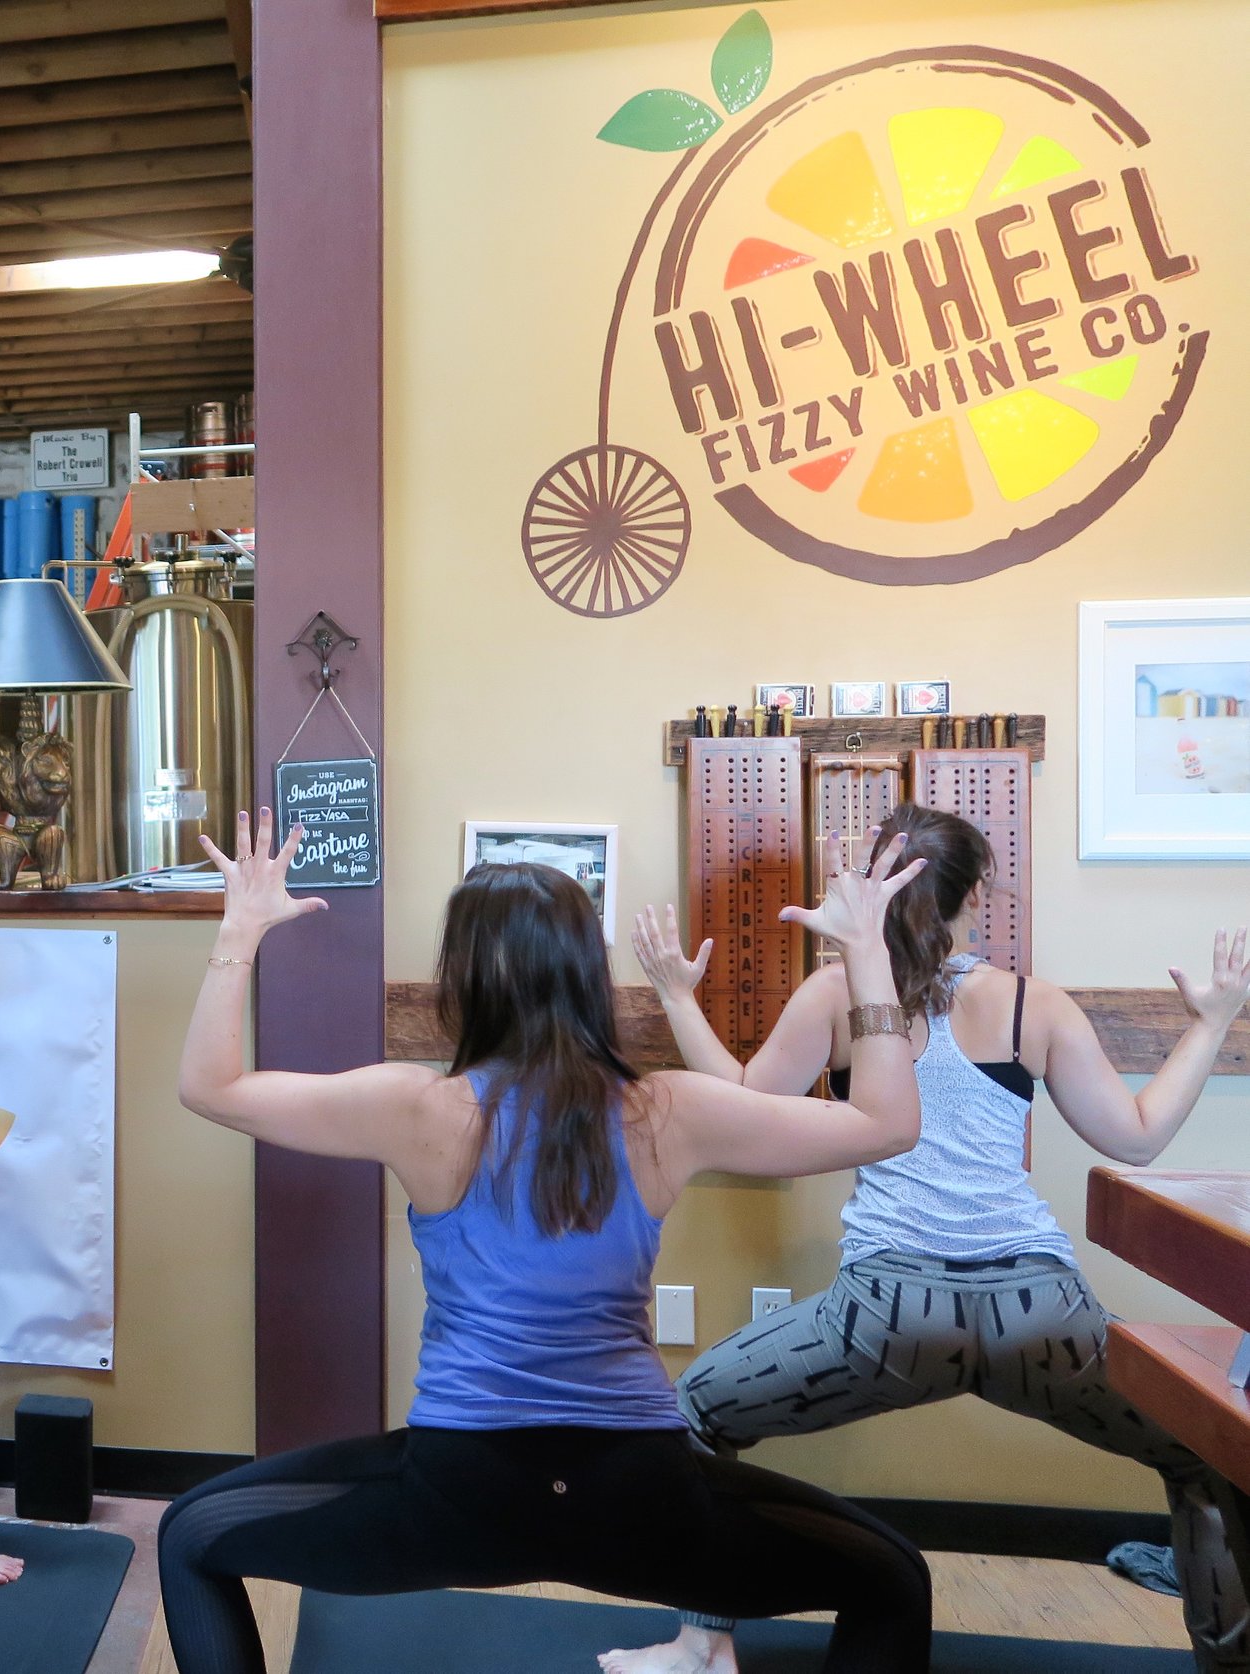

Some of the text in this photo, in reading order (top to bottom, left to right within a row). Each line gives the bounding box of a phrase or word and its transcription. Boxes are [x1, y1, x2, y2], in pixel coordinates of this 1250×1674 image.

[654, 167, 1198, 435] HI-WHEEL
[701, 294, 1191, 484] FIZZY WINE CO.
[81, 433, 96, 442] By
[62, 446, 77, 456] The
[37, 457, 102, 470] Robert Crowell
[62, 471, 78, 482] Trio
[287, 778, 368, 804] Instagram
[313, 830, 322, 838] us
[290, 833, 369, 869] Capture
[333, 861, 367, 877] the fun
[741, 846, 752, 1016] CRIBBAGE
